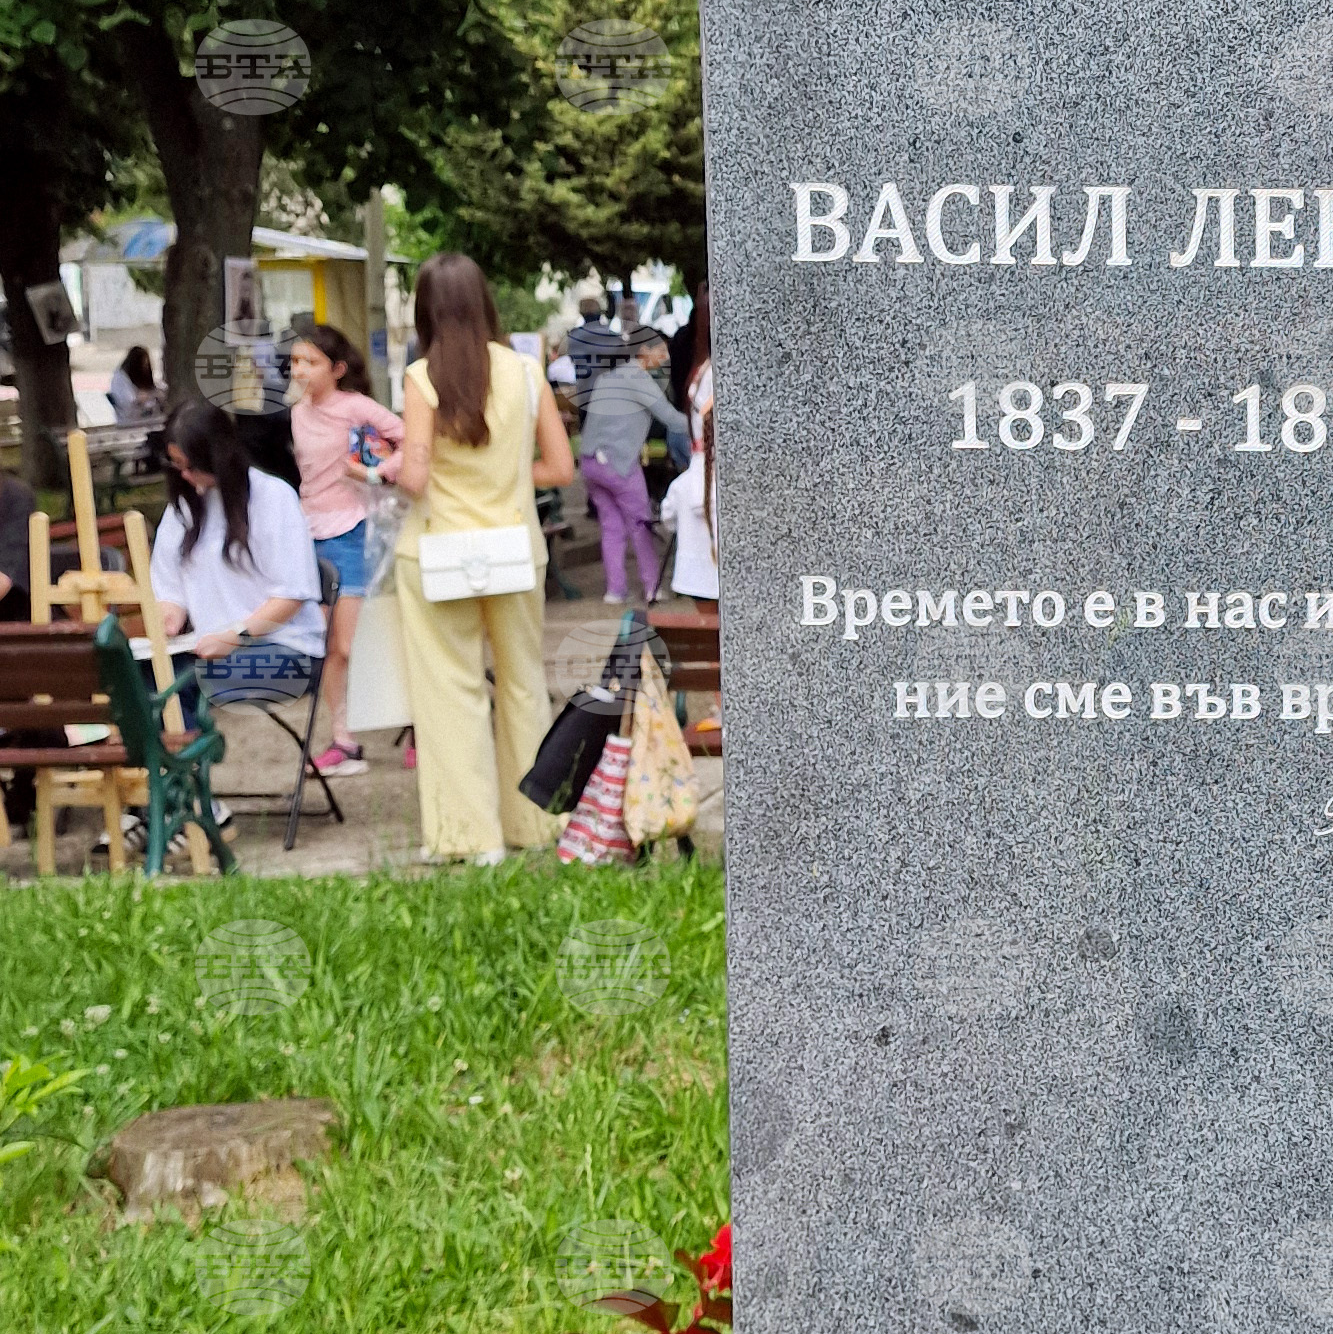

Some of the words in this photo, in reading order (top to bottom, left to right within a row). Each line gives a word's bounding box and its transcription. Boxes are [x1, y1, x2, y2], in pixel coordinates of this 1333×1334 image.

[788, 180, 1133, 267] ВАСИЛ
[948, 379, 1150, 452] 1837
[798, 574, 1067, 641] Времето
[1083, 589, 1117, 629] е
[1133, 589, 1167, 629] в
[1183, 590, 1289, 631] нас
[892, 679, 1008, 720] ние
[1023, 679, 1133, 721] сме
[1149, 681, 1263, 722] във
